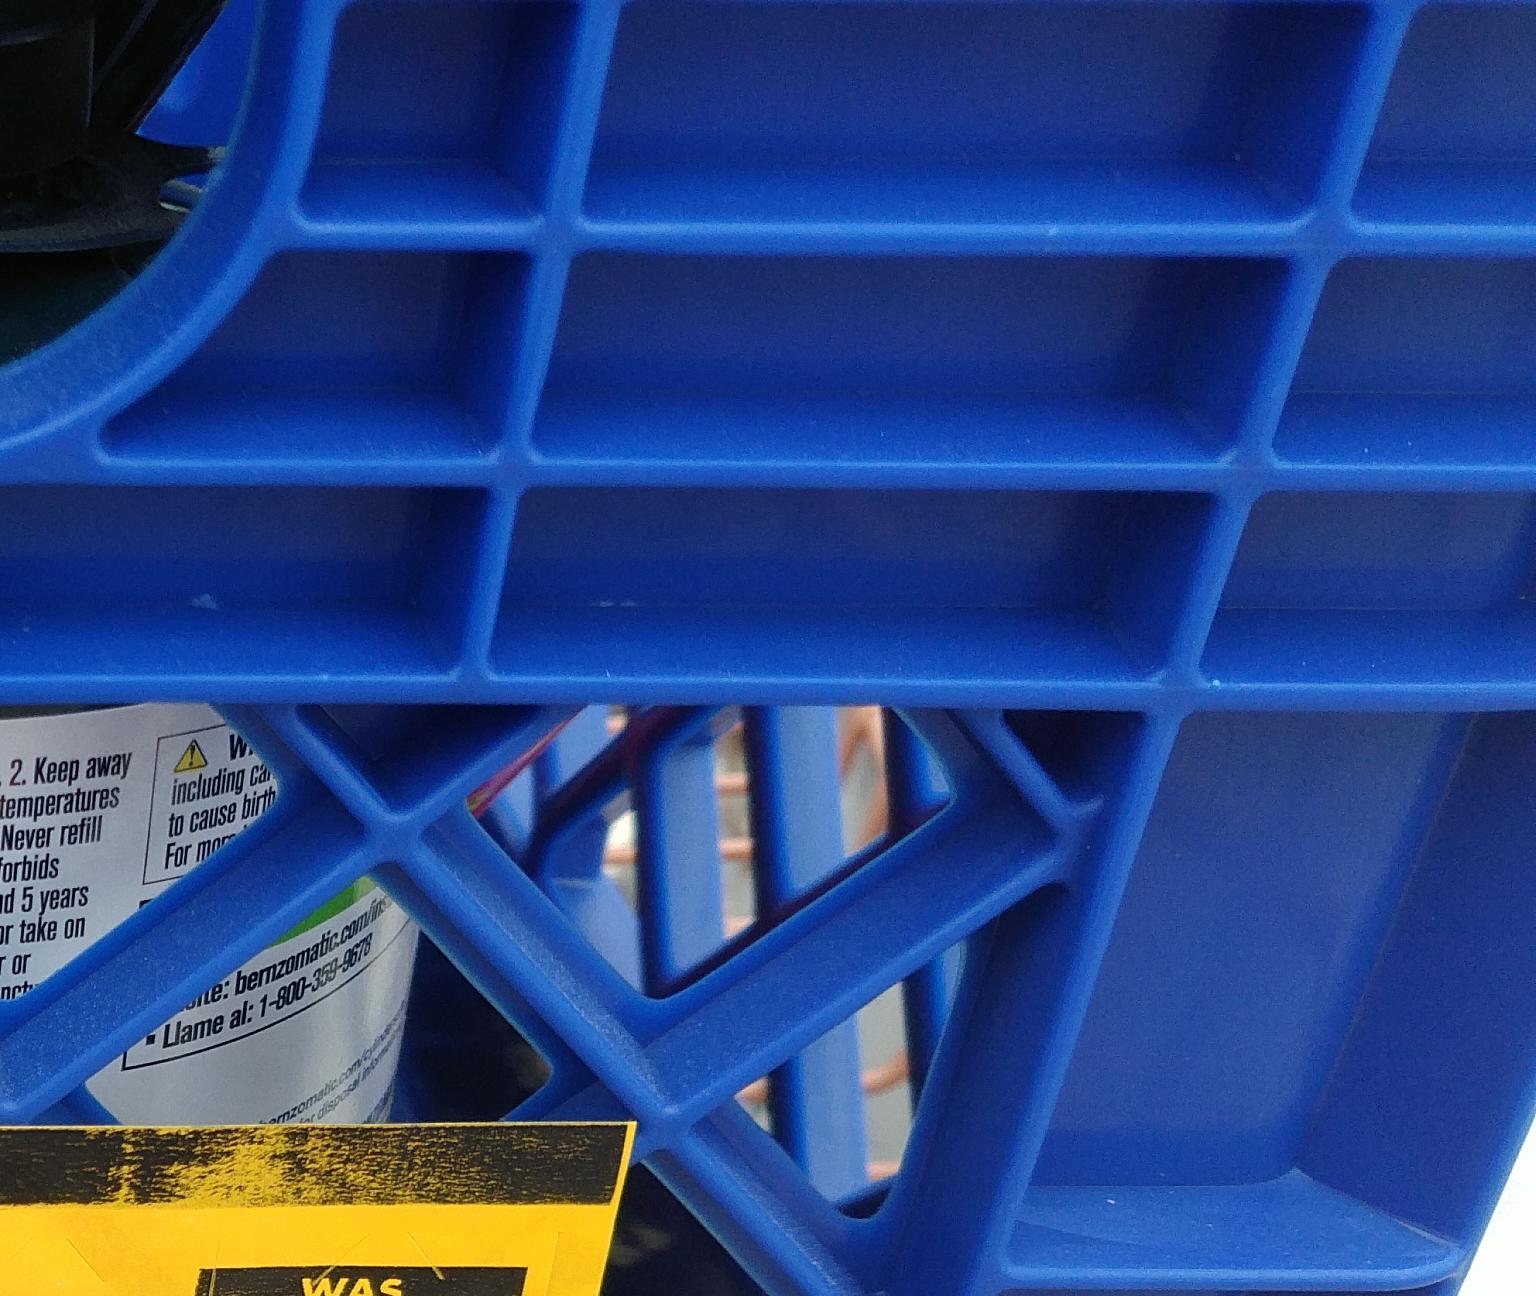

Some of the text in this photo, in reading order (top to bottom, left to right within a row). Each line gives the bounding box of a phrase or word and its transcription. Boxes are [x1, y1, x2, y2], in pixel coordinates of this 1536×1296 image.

[9, 759, 27, 786] 2.
[34, 755, 80, 790] Keep
[86, 751, 133, 781] away
[171, 767, 246, 806] including
[0, 784, 120, 822] temperatures
[168, 786, 276, 838] to cause birth
[1, 824, 53, 852] Never
[59, 815, 103, 846] refill
[164, 842, 192, 870] For
[21, 887, 34, 912] 5
[38, 884, 89, 921] years
[19, 917, 58, 944] take
[63, 915, 86, 940] on
[12, 953, 31, 975] or
[162, 1008, 224, 1049] Llame
[229, 1002, 254, 1030] al:
[259, 932, 373, 1018] 1-800-359-9678
